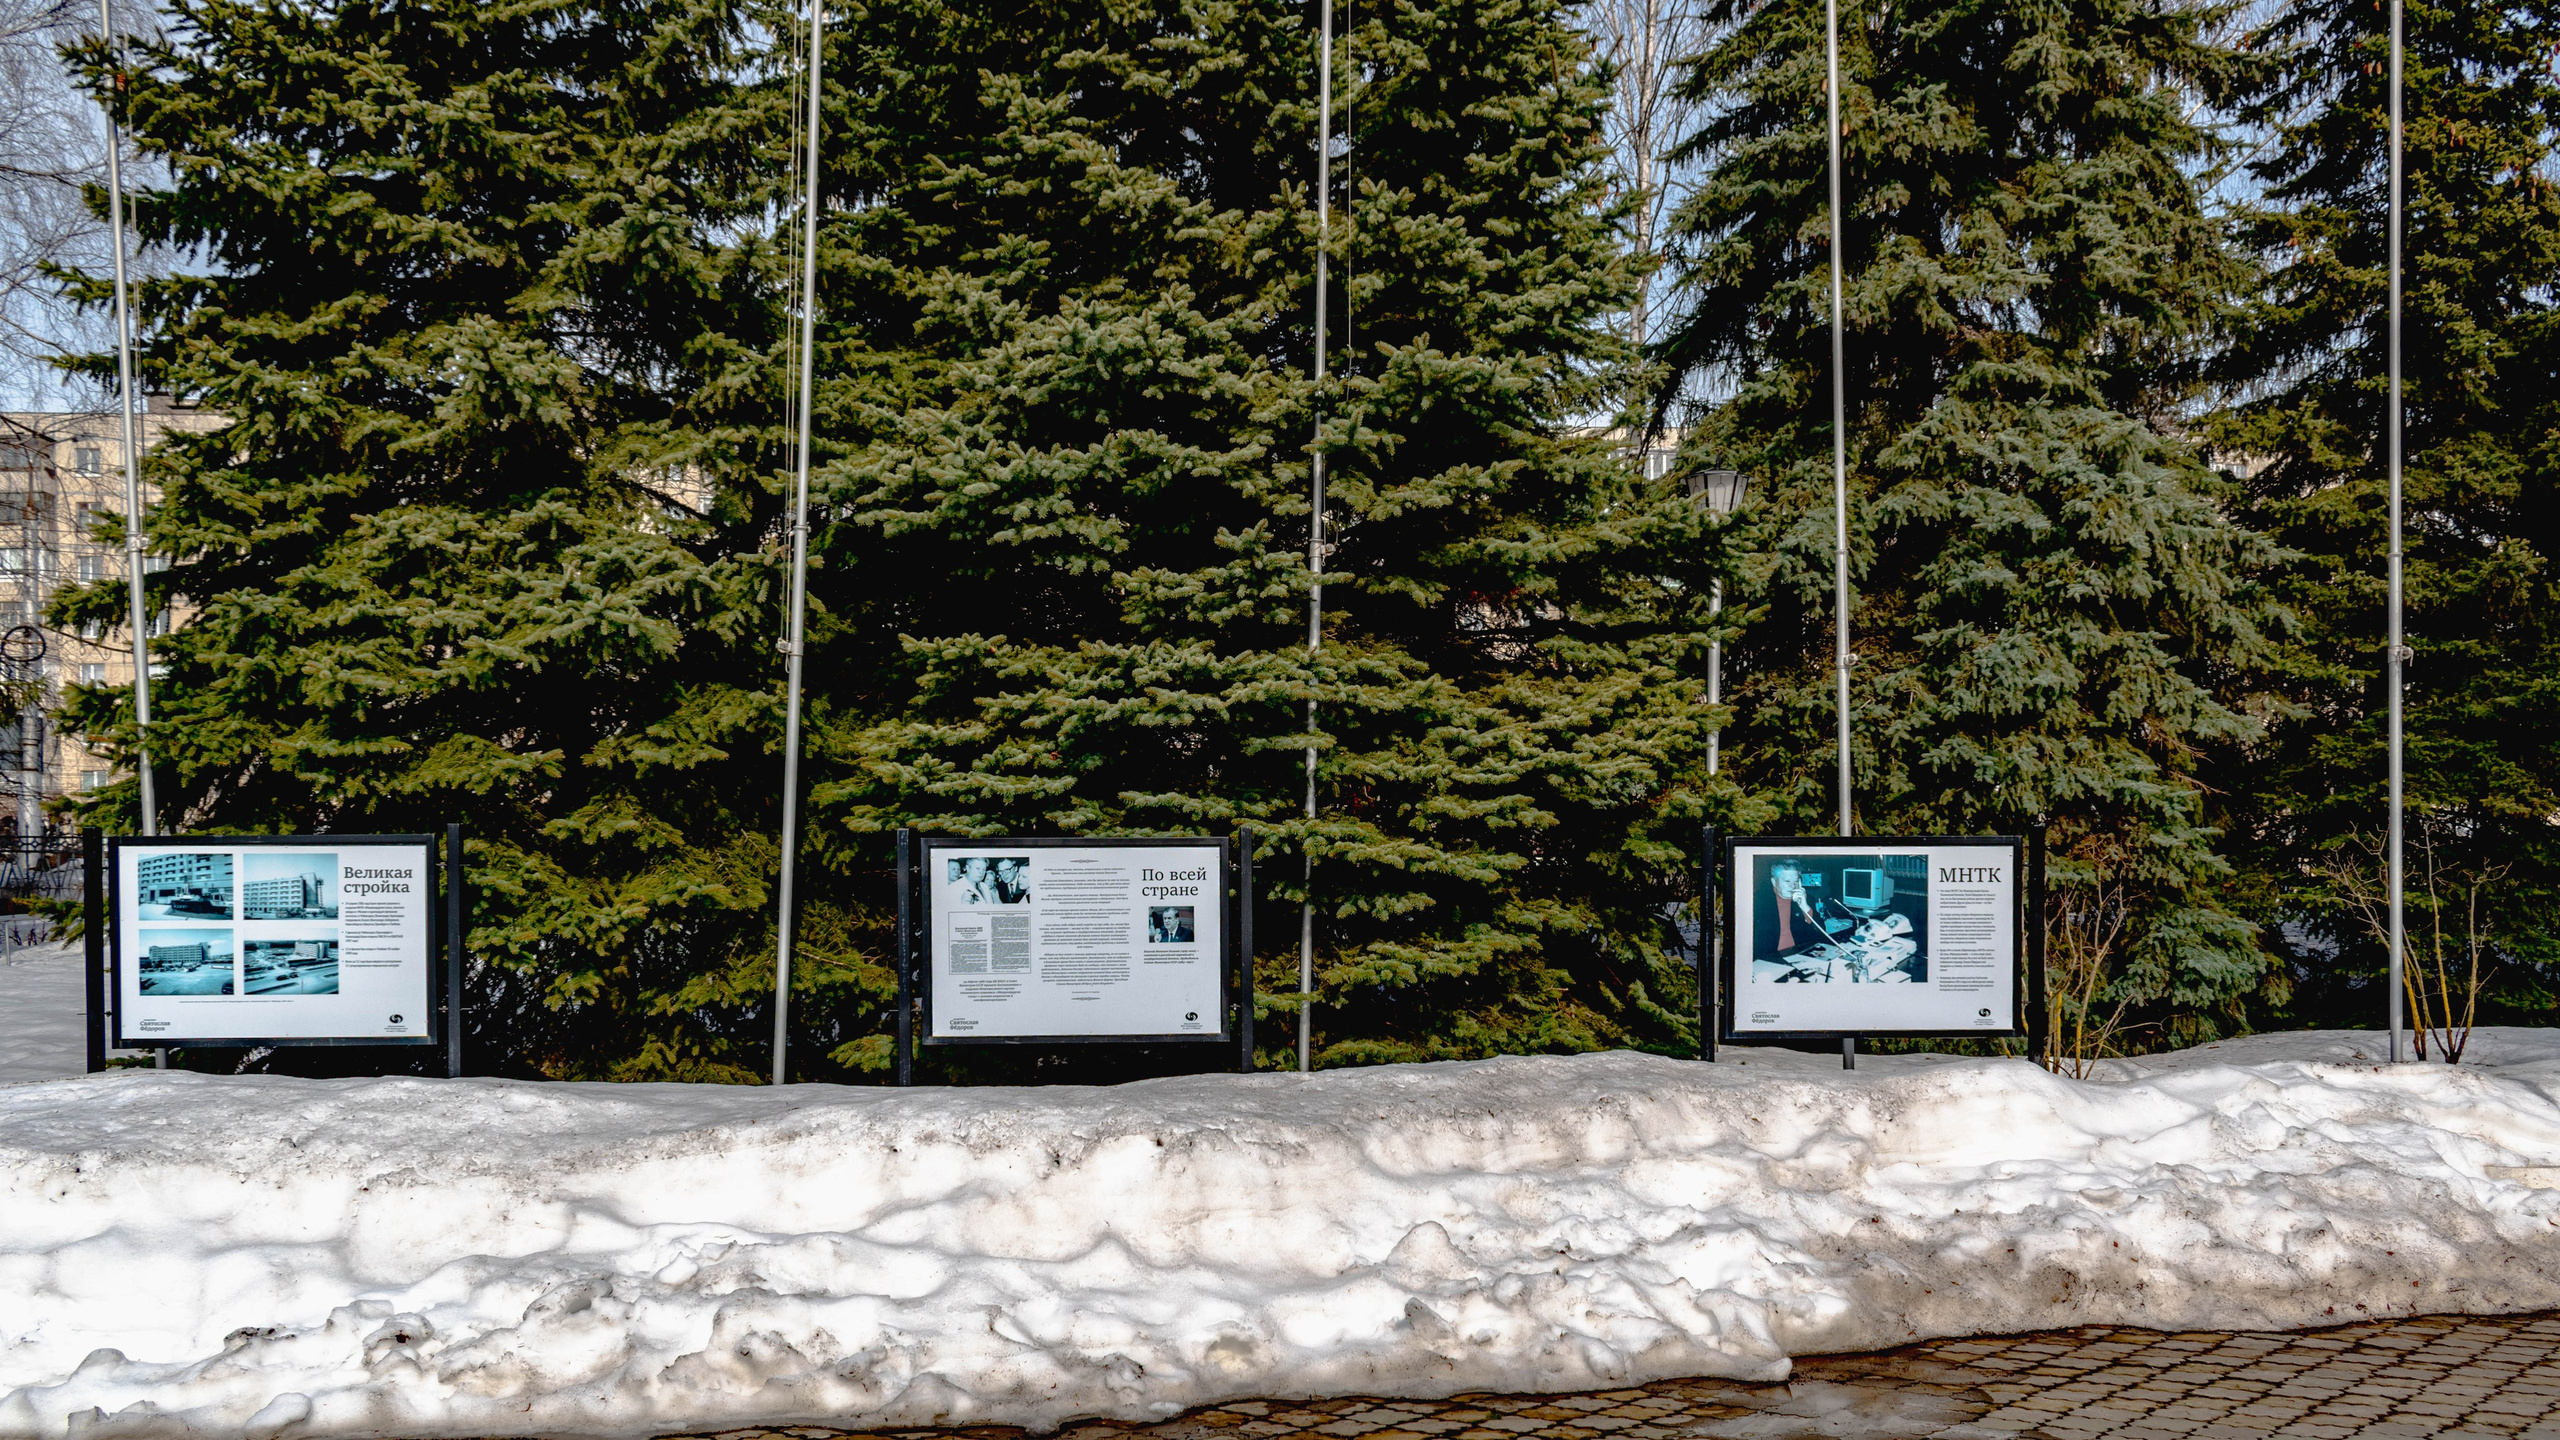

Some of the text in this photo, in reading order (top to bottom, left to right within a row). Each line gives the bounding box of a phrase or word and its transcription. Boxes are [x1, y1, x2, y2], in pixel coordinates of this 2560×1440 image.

[343, 866, 413, 879] Великая
[1142, 868, 1164, 881] По
[1169, 867, 1207, 881] всей
[1939, 867, 2002, 883] МНТК
[343, 880, 410, 896] стройка
[1142, 885, 1199, 900] стране
